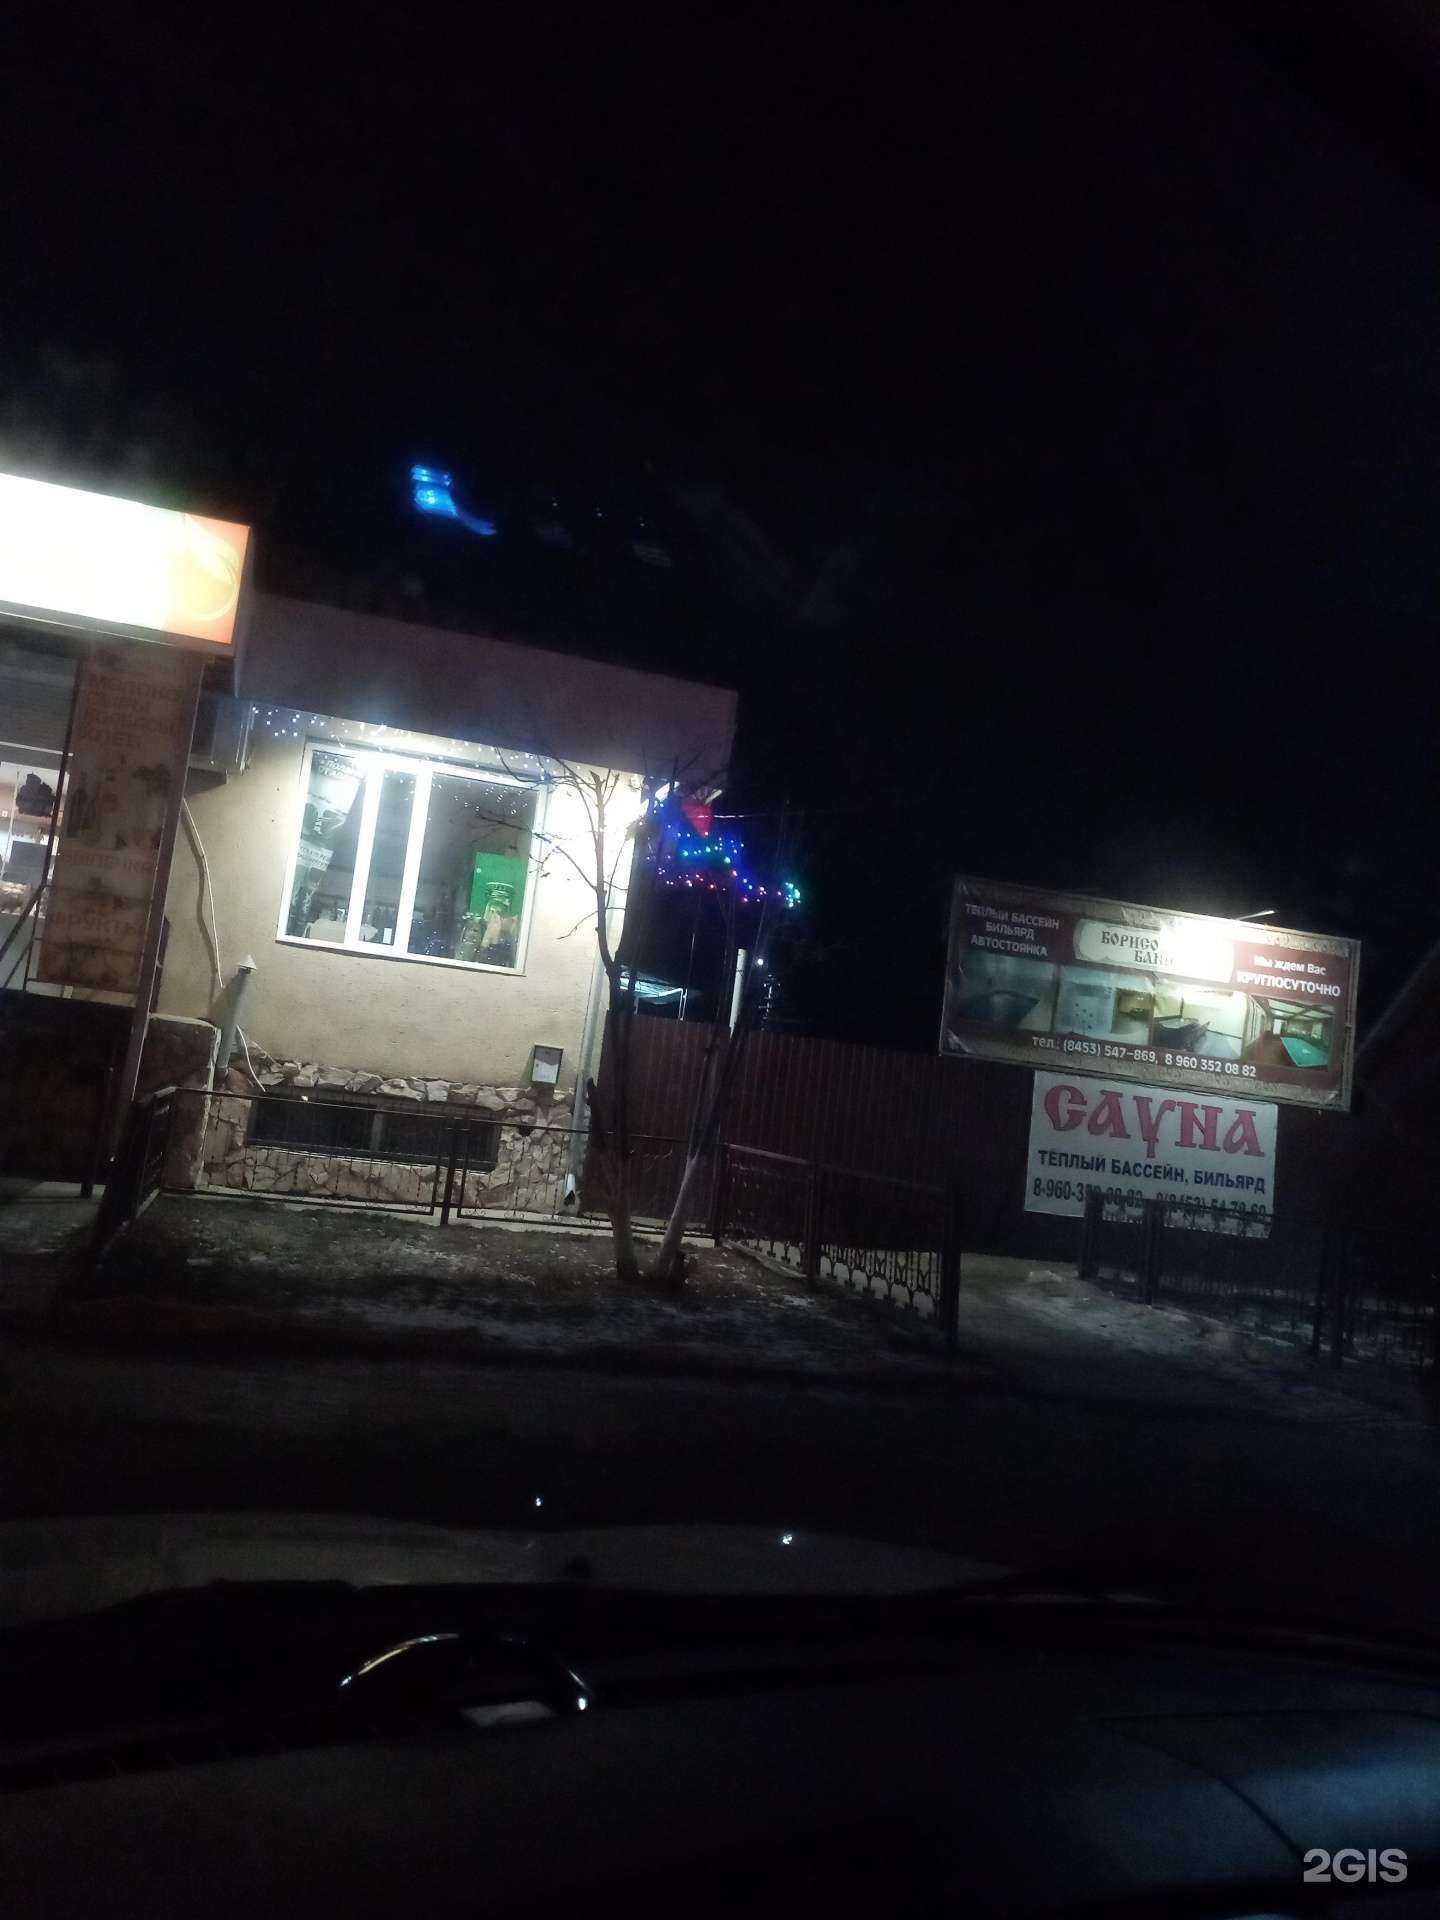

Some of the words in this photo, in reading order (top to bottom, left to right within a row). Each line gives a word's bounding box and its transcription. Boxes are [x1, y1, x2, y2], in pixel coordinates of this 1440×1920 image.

[985, 920, 1035, 940] БИЛЬЯРД
[1011, 912, 1061, 929] БАССЕЙН
[970, 934, 1048, 956] АВТОСТОЯНКА
[1101, 930, 1159, 951] БОРИСО
[1274, 959, 1305, 973] ждем
[1307, 963, 1327, 976] Вас
[1237, 971, 1341, 997] КРУГЛОСУТОЧНО
[1063, 1039, 1101, 1056] (8453)
[1165, 1053, 1173, 1064] 8
[1175, 1056, 1197, 1068] 960
[1200, 1058, 1222, 1073] 352
[1224, 1063, 1239, 1075] 08
[1242, 1065, 1257, 1078] 82
[1044, 1085, 1265, 1159] САУНА
[1111, 1158, 1189, 1184] БАССЕЙН,
[1194, 1169, 1266, 1195] БИЛЬЯРД
